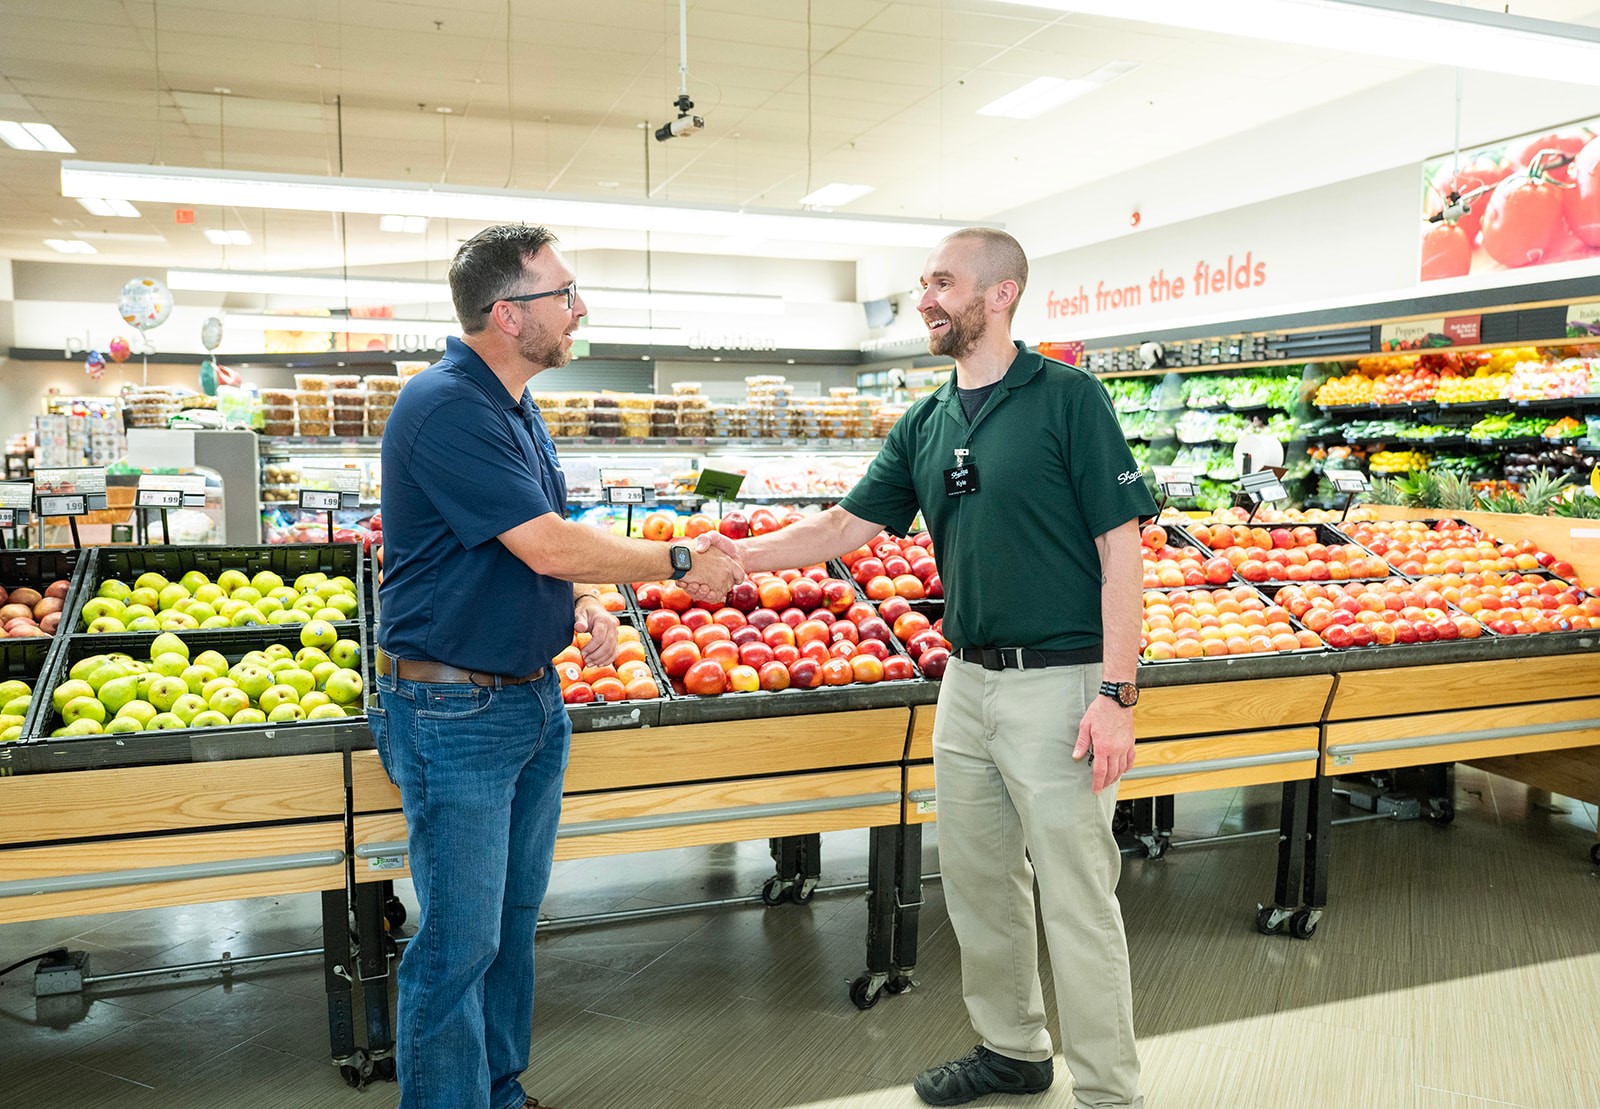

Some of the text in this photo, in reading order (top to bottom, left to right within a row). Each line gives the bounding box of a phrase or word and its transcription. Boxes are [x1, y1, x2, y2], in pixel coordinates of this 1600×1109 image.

[1046, 251, 1266, 319] fresh from the fields
[1395, 326, 1425, 338] Peppers
[688, 328, 776, 351] dietitian
[163, 496, 178, 504] 1.99
[65, 502, 83, 511] 1.99
